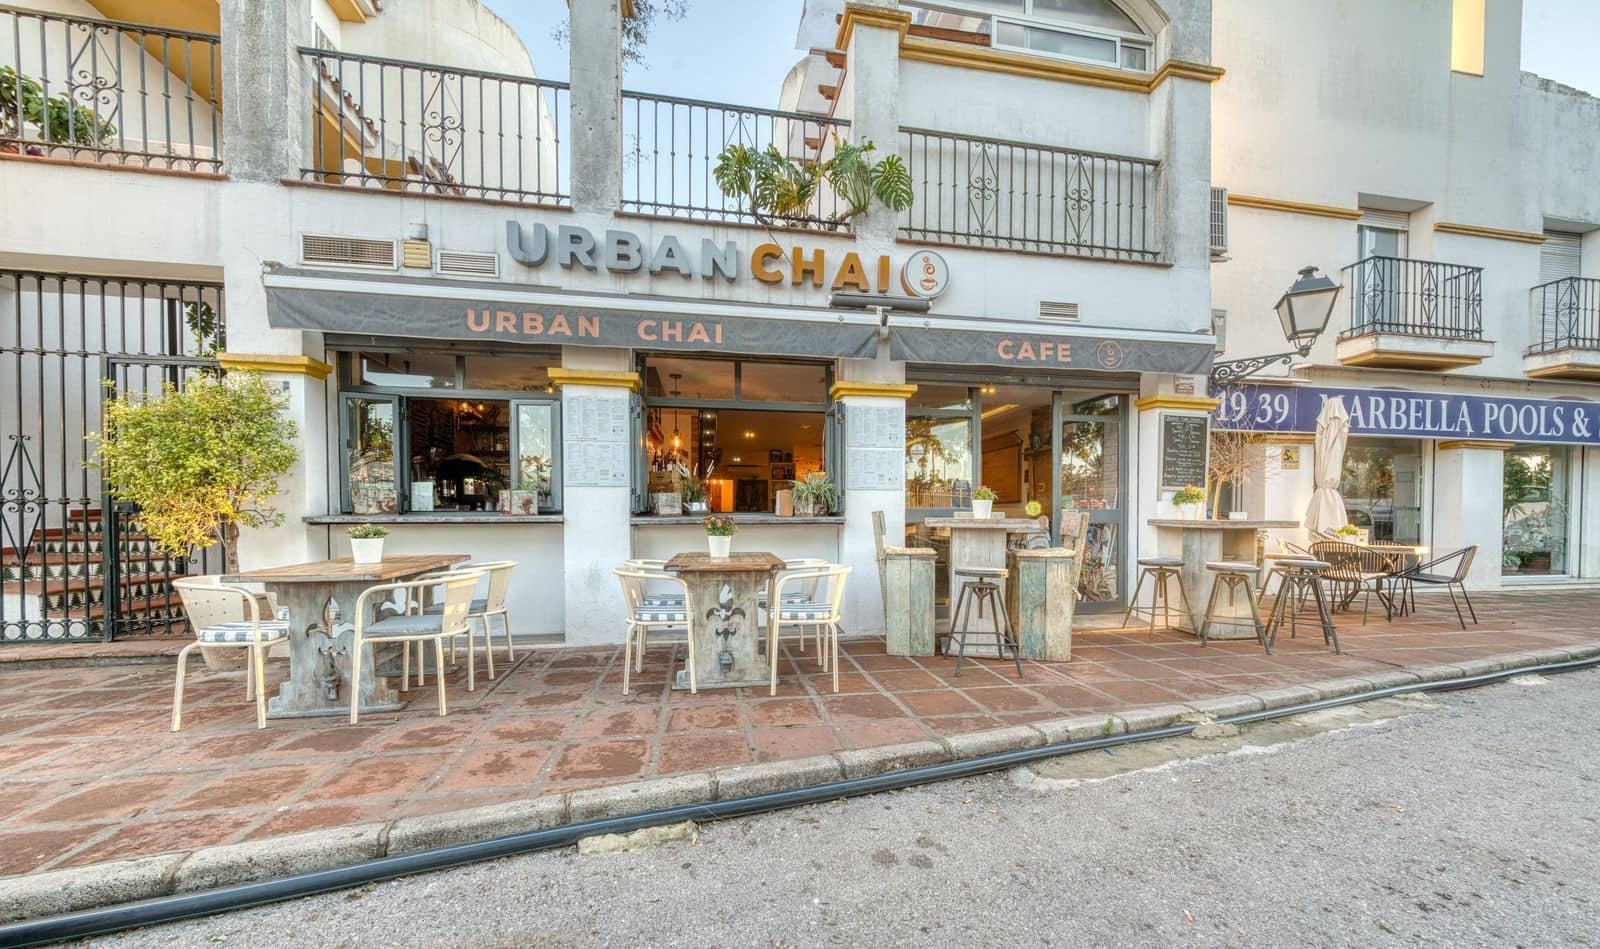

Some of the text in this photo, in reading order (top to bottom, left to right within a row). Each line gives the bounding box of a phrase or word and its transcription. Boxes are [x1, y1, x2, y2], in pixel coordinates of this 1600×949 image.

[466, 307, 723, 344] URBAN CHAI
[997, 339, 1072, 363] CAFE
[1256, 393, 1290, 424] 39
[1482, 402, 1564, 437] POOLS
[1572, 407, 1591, 438] &
